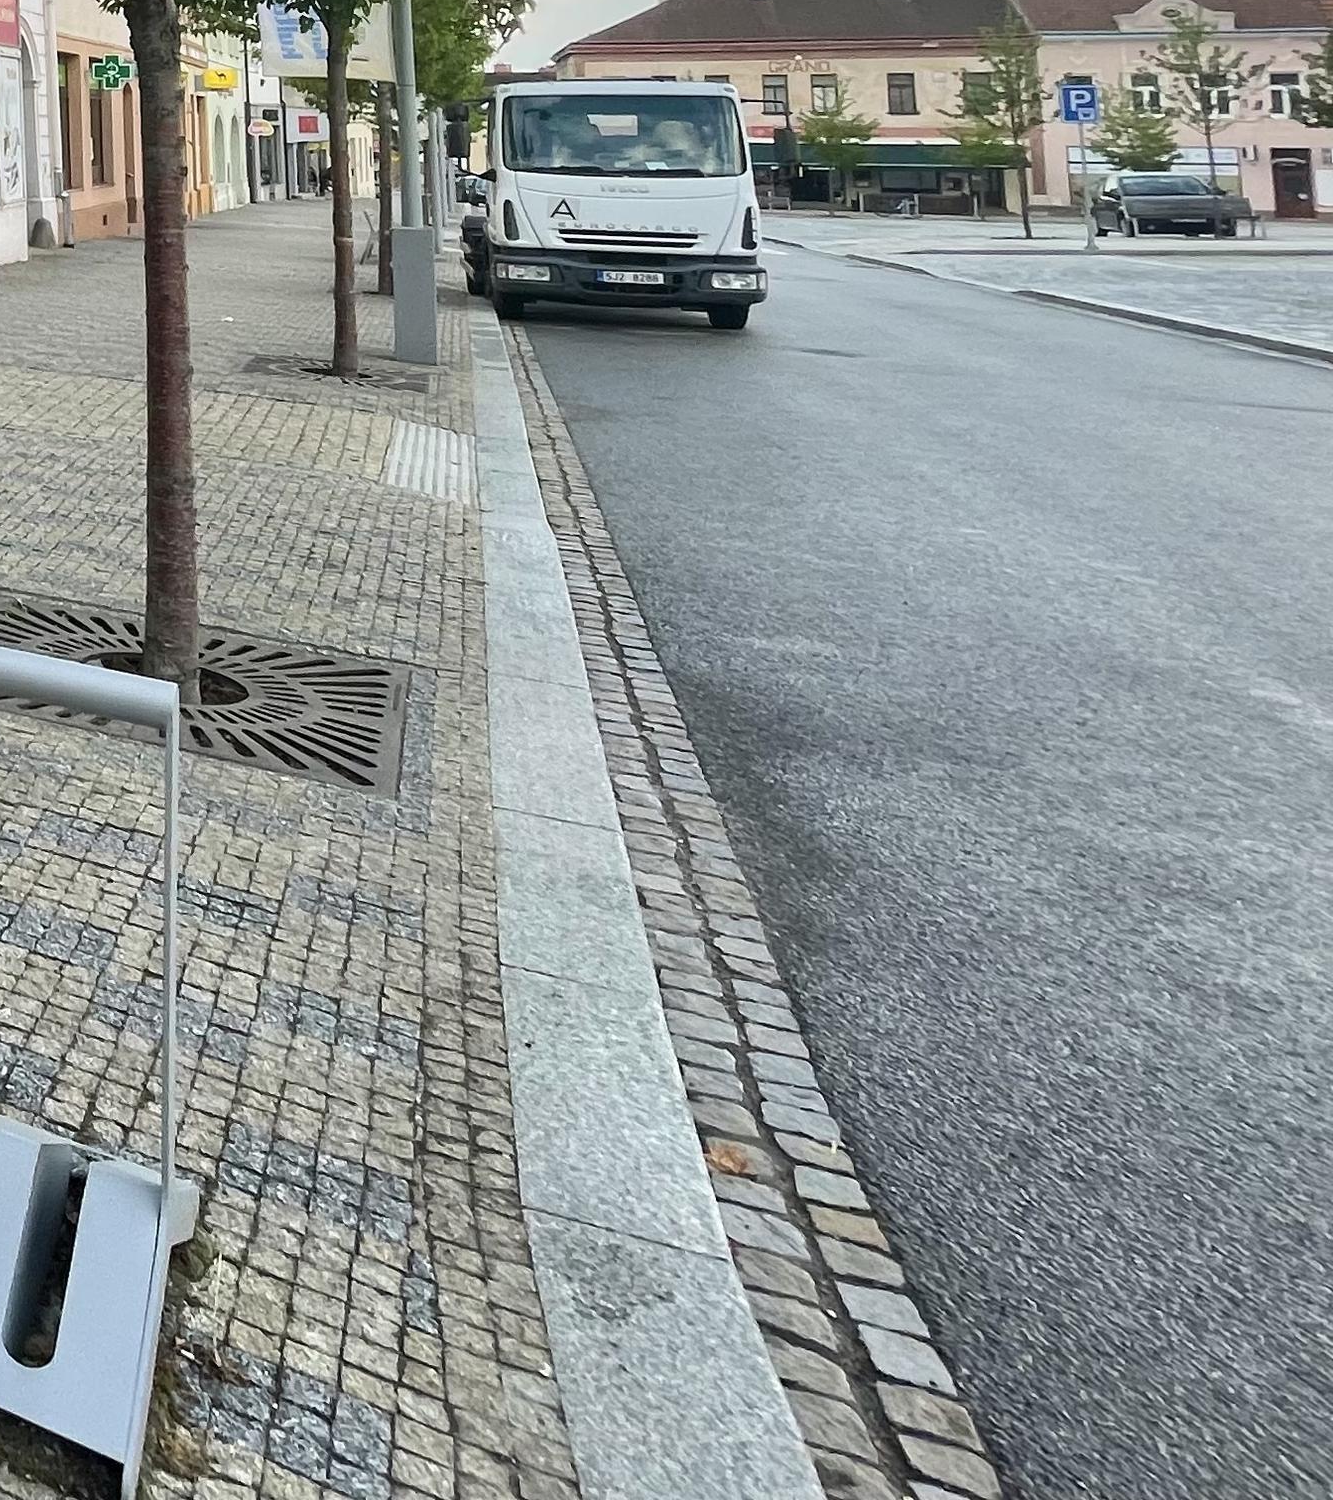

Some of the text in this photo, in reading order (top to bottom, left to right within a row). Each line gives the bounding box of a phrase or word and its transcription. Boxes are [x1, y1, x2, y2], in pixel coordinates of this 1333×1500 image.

[769, 60, 830, 73] GRAND
[1070, 90, 1091, 112] P
[550, 198, 576, 220] A
